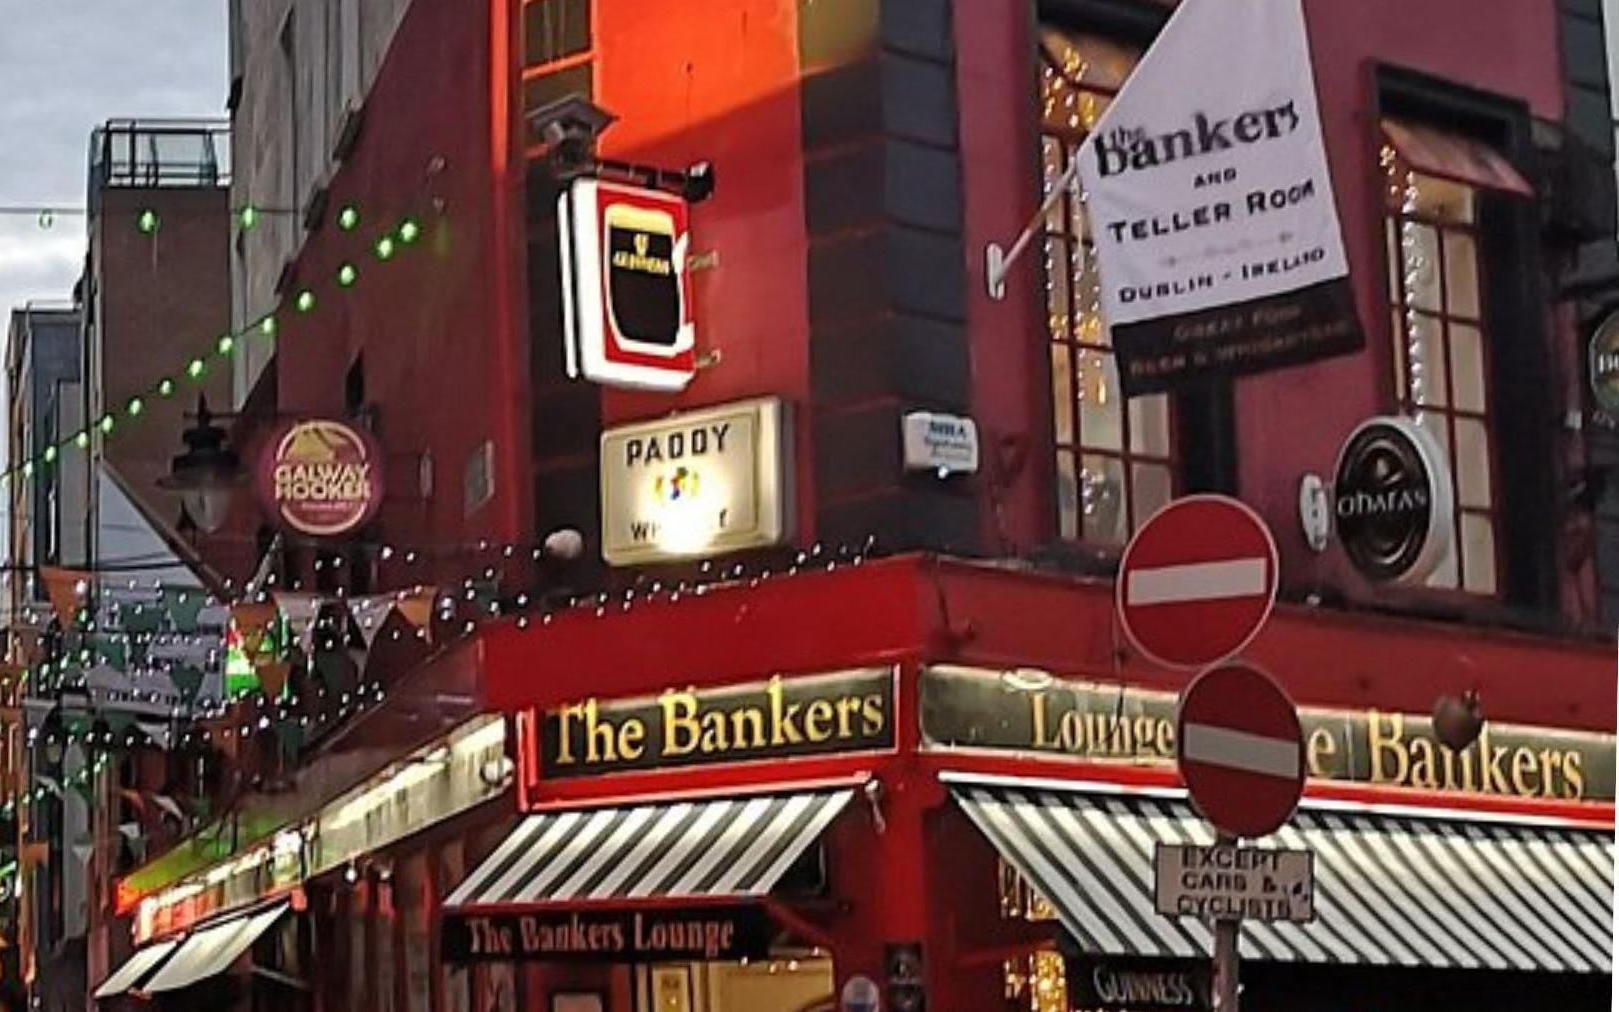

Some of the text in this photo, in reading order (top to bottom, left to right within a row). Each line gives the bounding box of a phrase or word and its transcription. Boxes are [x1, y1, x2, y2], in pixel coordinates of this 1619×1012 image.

[1194, 168, 1237, 188] AND
[1108, 179, 1316, 242] TELLER ROOM
[1118, 275, 1213, 302] DUBLIN
[626, 423, 729, 466] PADDY
[275, 463, 370, 482] GALWAY
[274, 480, 371, 500] HOOKER
[555, 674, 883, 763] The Bankers
[1029, 692, 1174, 764] Lounge
[1366, 708, 1583, 800] Bankers
[1183, 847, 1278, 871] EXCEPT
[1182, 871, 1247, 891] CARS
[1178, 895, 1290, 918] CYCLISTS
[466, 912, 734, 957] The Bankers Lounge
